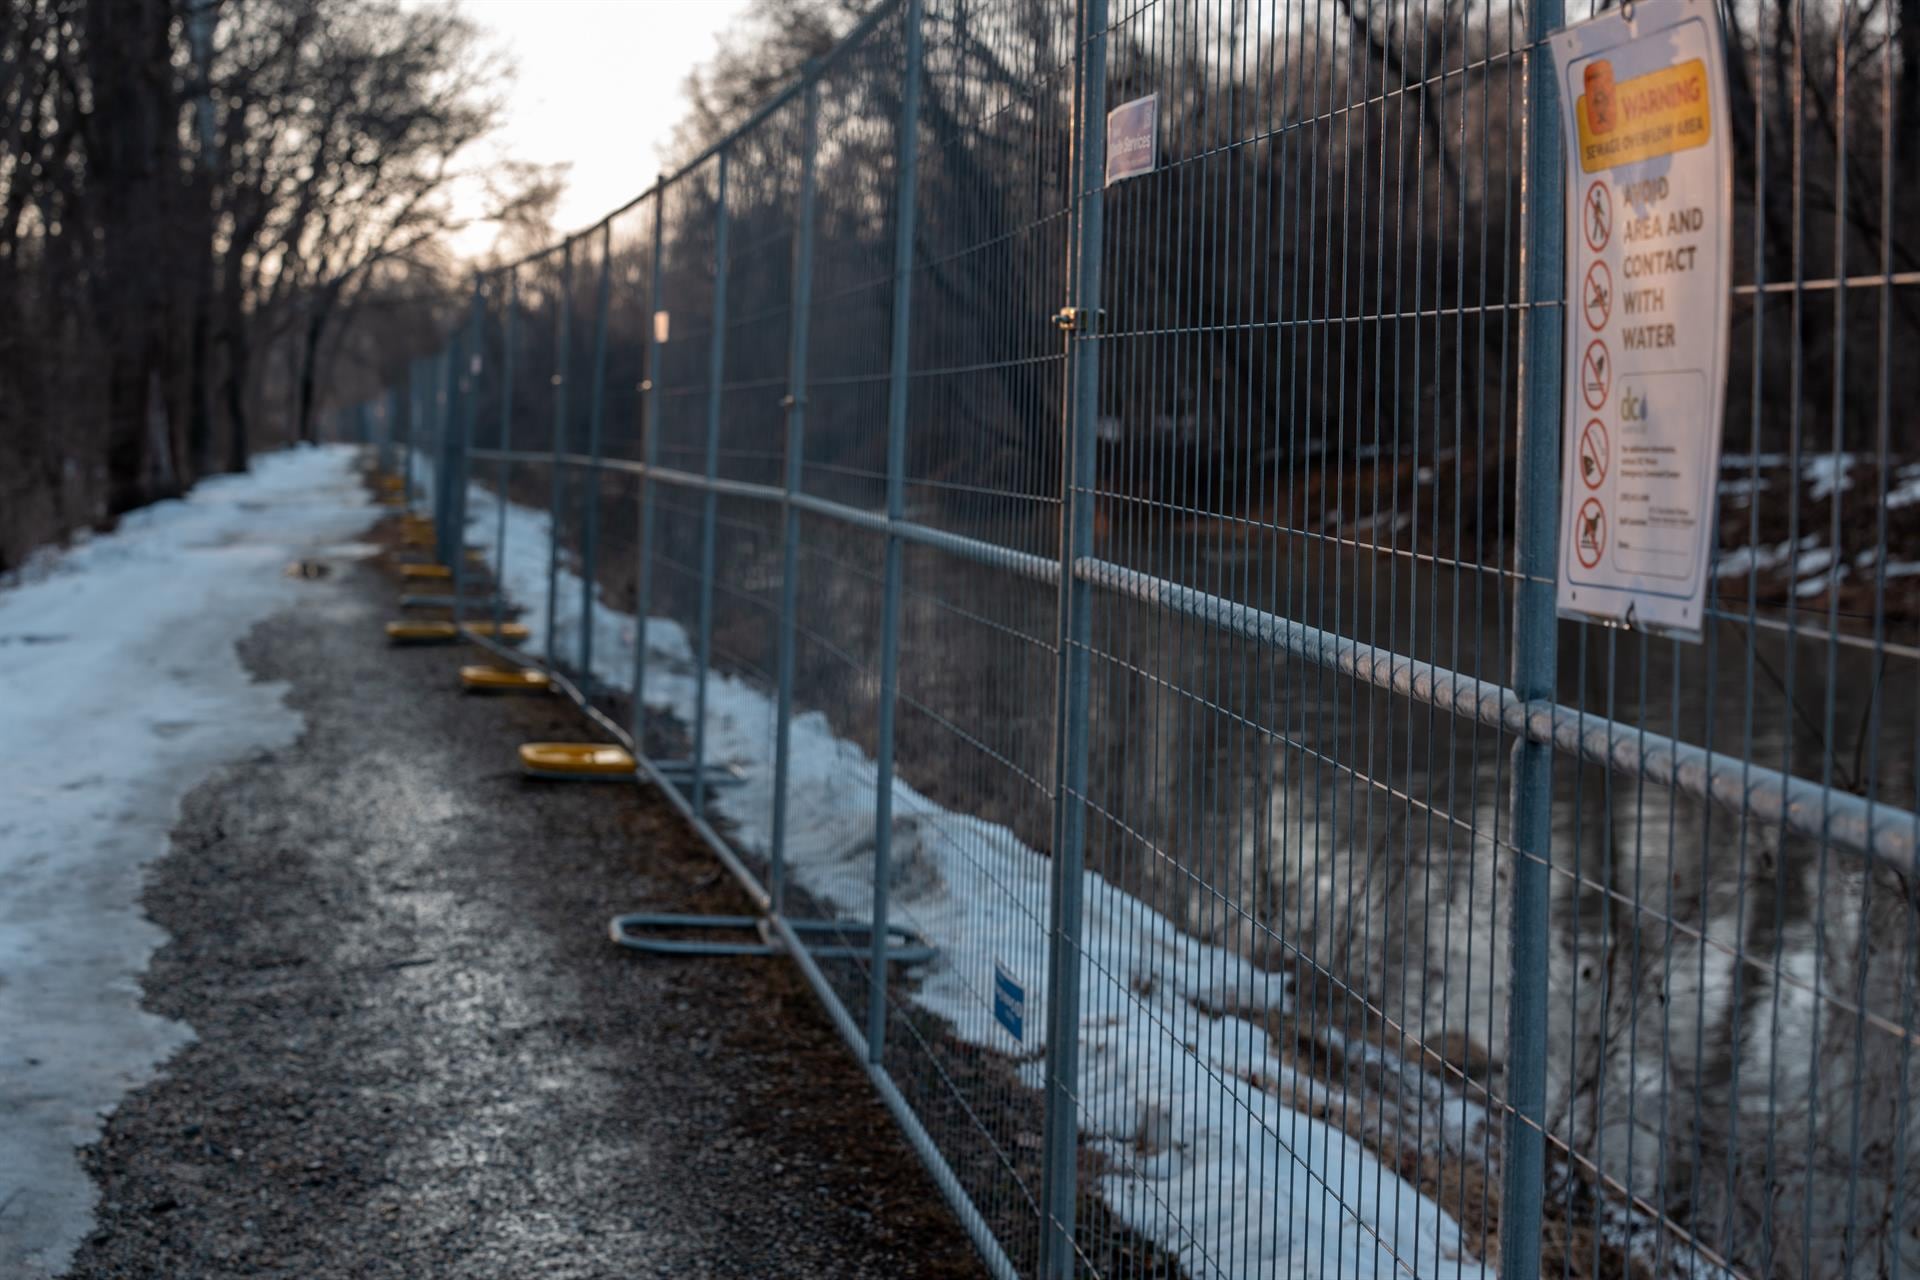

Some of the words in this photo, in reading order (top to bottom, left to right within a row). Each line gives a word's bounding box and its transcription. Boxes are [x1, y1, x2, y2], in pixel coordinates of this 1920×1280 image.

[1622, 77, 1701, 121] WARNING
[1623, 176, 1669, 207] AVOID
[1623, 214, 1663, 244] AREA
[1667, 207, 1704, 236] AND
[1623, 246, 1697, 280] CONTACT
[1622, 288, 1665, 315] WITH
[1622, 323, 1676, 350] WATER
